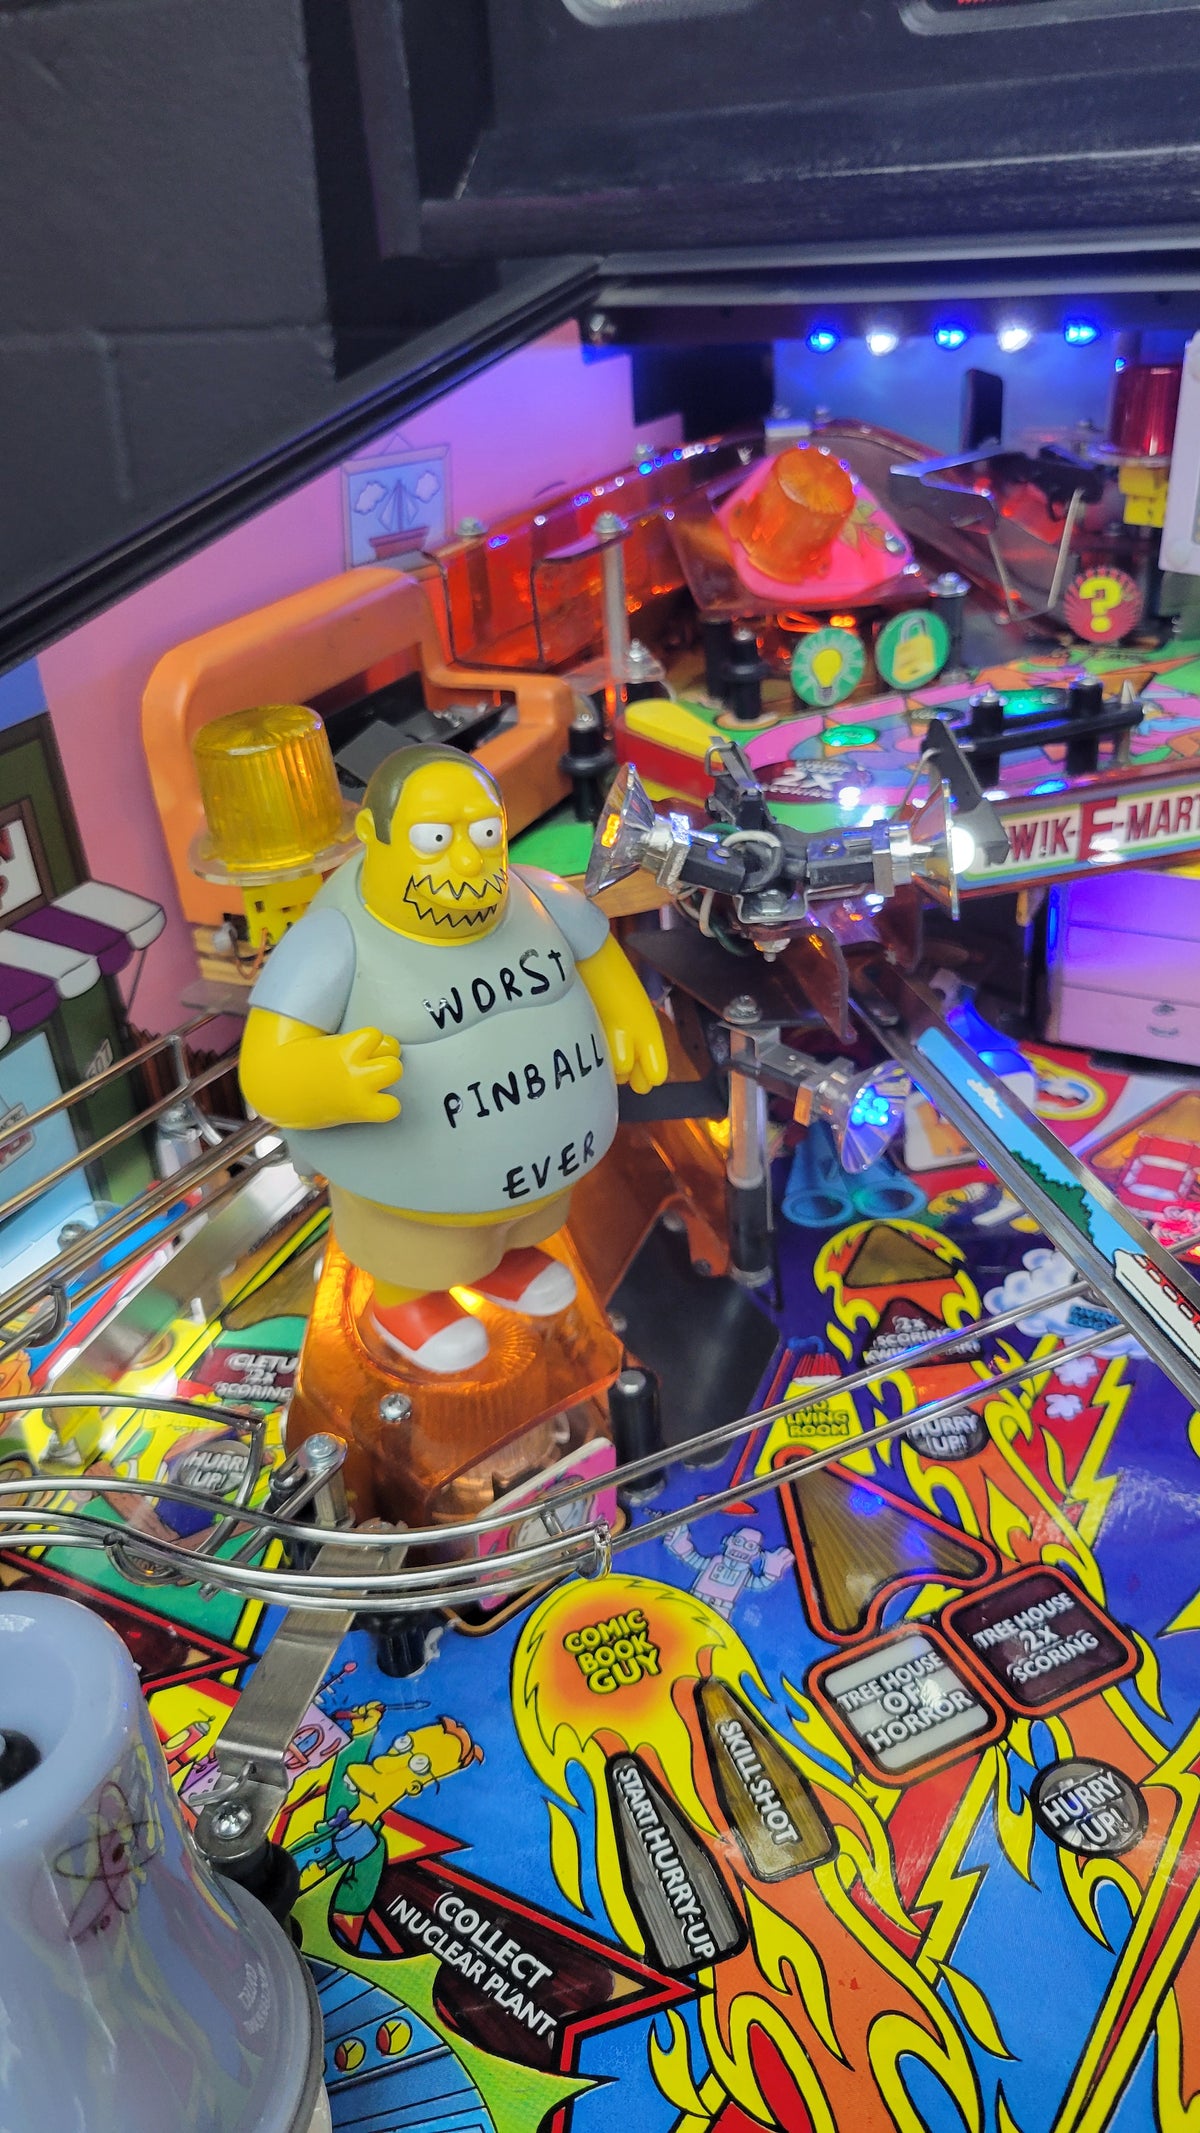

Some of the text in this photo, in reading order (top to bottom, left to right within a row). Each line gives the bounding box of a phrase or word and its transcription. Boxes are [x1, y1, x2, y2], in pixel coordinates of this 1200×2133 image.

[422, 949, 566, 1029] WORST
[443, 1033, 604, 1129] PINBALL
[502, 1130, 595, 1199] EVER
[228, 1353, 299, 1374] CLETU
[786, 1410, 848, 1426] LIVING
[789, 1424, 850, 1437] ROOM
[563, 1610, 648, 1654] COMIC
[1013, 1592, 1076, 1630] HOUSE
[577, 1631, 655, 1675] BOOK
[588, 1648, 660, 1694] GUY
[1011, 1631, 1100, 1685] SCORING
[836, 1651, 945, 1712] TREE HOUSE
[882, 1681, 921, 1715] OF
[865, 1690, 974, 1752] HORROR
[618, 1766, 660, 1828] START
[719, 1720, 799, 1841] SKILL SHOT
[1041, 1771, 1122, 1828] HURRY
[1080, 1807, 1129, 1843] UP!
[390, 1899, 558, 2036] NUCLEAR PLANT
[437, 1896, 554, 1989] COLLECT
